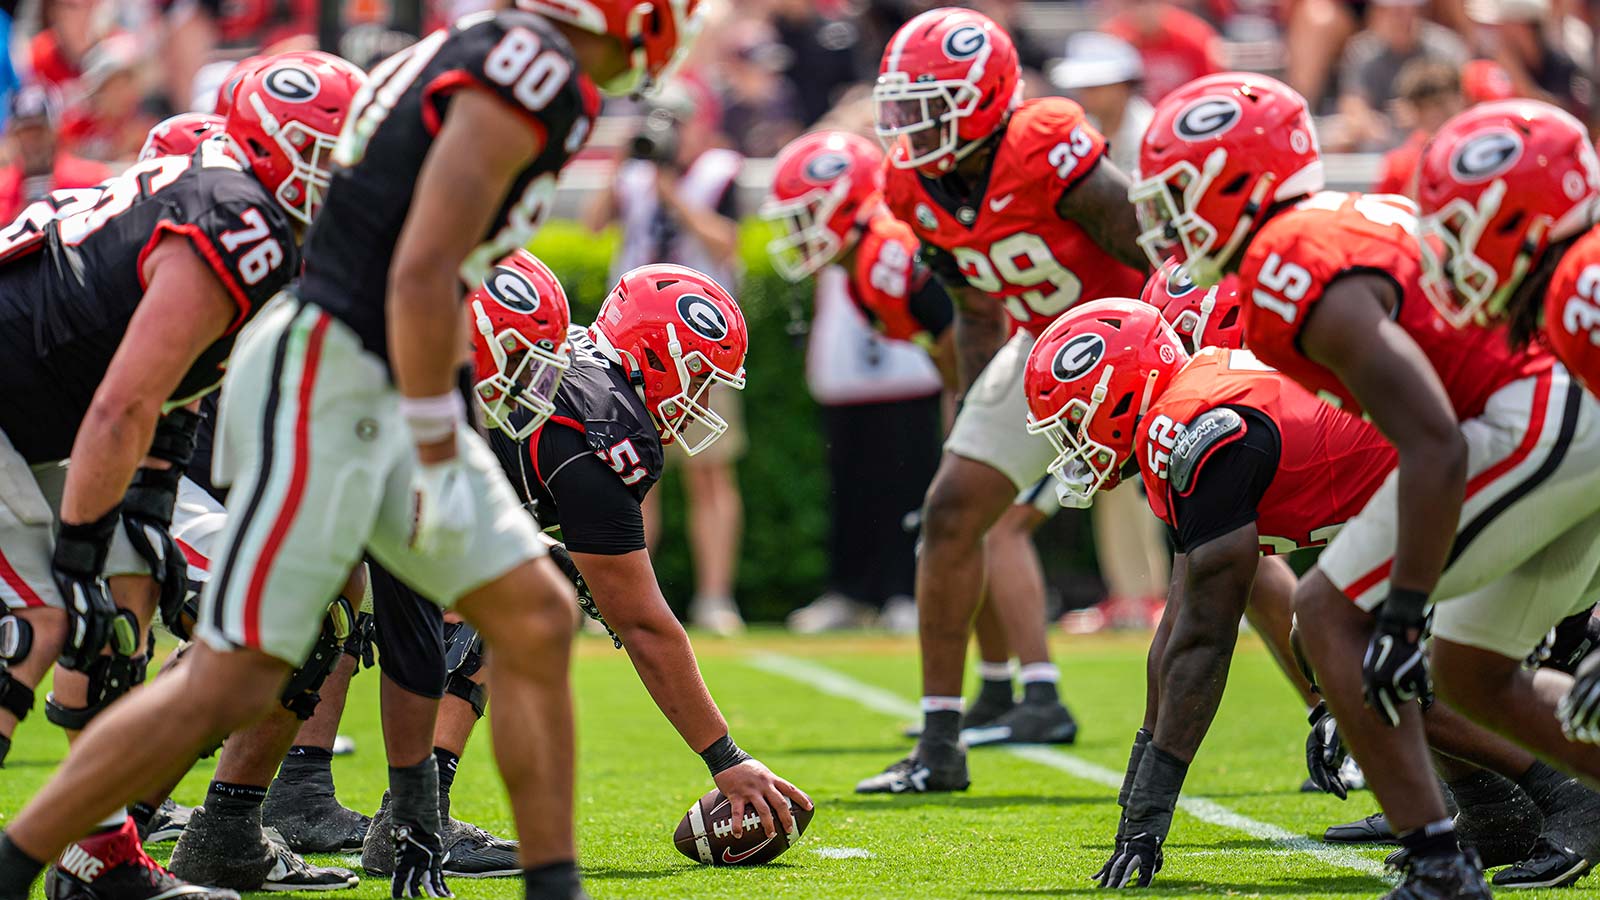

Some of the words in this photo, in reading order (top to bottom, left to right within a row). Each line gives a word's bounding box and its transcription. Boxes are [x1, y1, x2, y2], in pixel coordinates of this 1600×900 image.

[943, 26, 987, 58] G
[263, 67, 319, 102] G
[484, 26, 571, 112] 80
[1175, 97, 1240, 140] G
[1450, 129, 1521, 182] G
[219, 207, 284, 287] 76
[484, 266, 539, 314] G
[1251, 252, 1313, 324] 15
[678, 294, 728, 341] G
[1052, 334, 1105, 382] G
[607, 437, 649, 487] 51
[1147, 414, 1187, 480] 52
[1178, 418, 1220, 460] GEAR
[59, 843, 105, 884] NIKE
